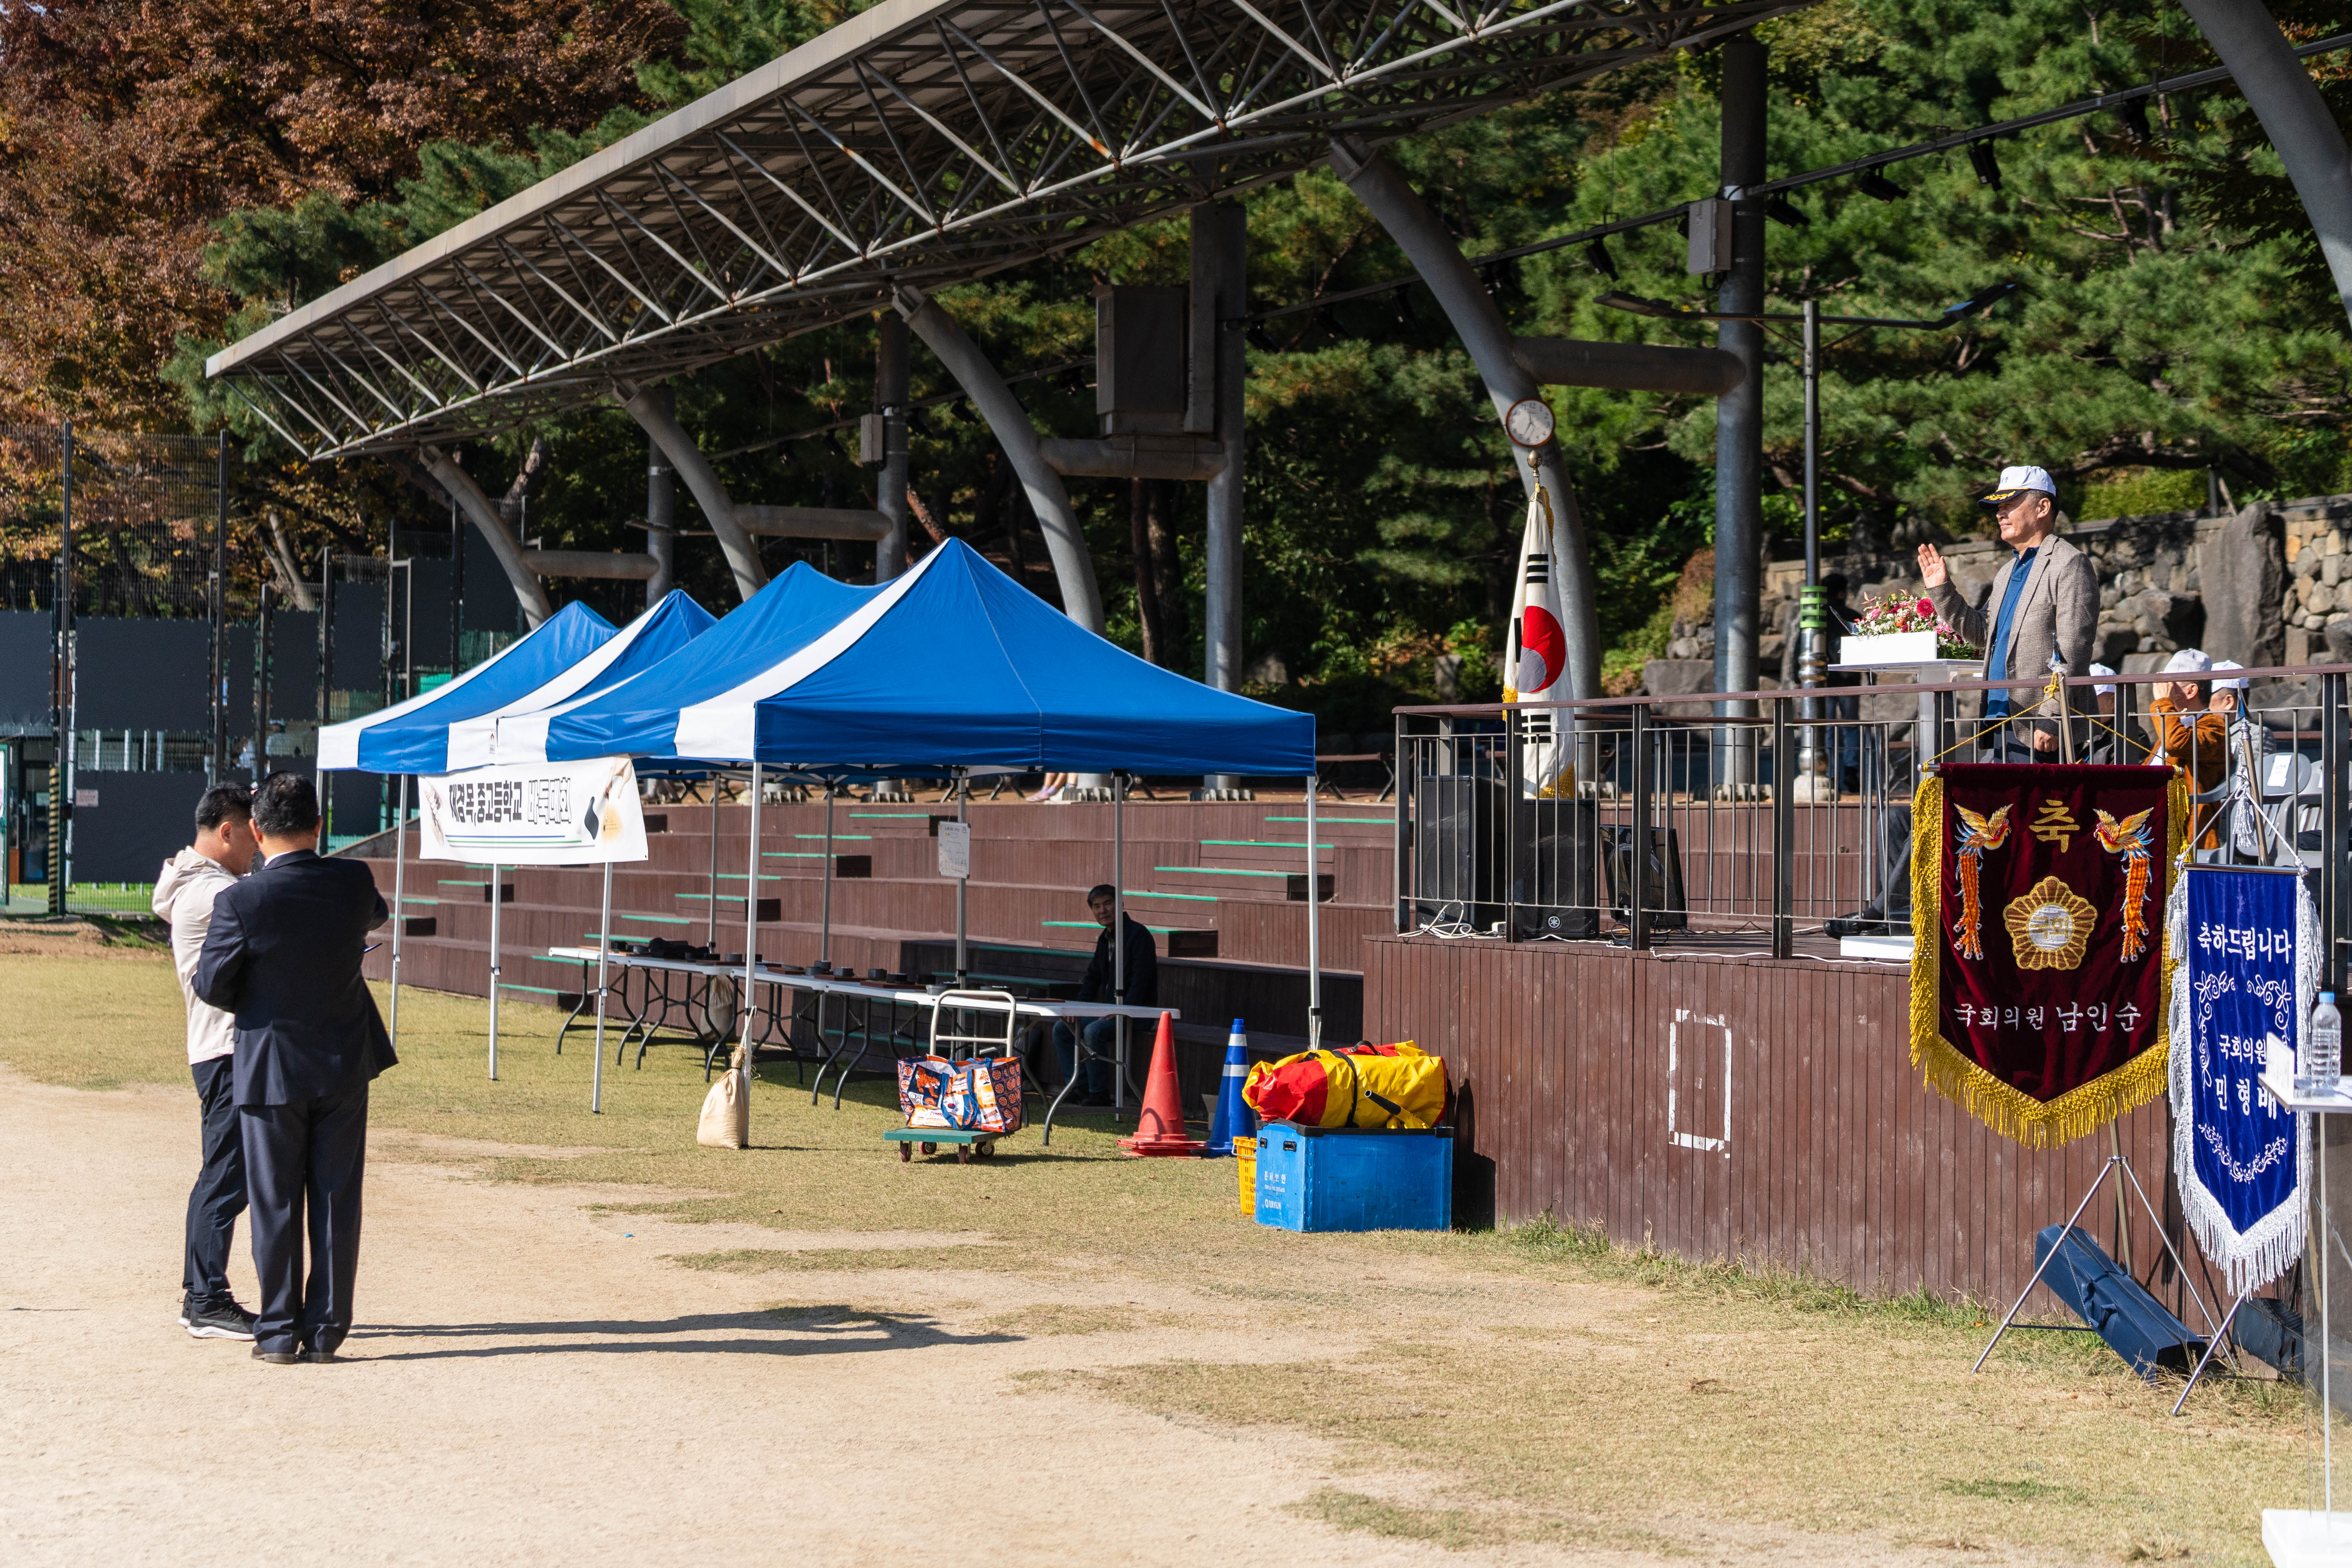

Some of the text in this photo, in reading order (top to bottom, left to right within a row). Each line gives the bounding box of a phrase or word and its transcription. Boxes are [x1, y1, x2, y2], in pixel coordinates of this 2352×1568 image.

[528, 777, 571, 825] 바둑대회
[2029, 799, 2080, 853] 축
[2030, 915, 2069, 939] 국회
[2197, 921, 2292, 964] 축하드립니다
[1954, 1001, 2141, 1032] 국회의원 남인순
[2219, 1034, 2267, 1065] 국회의원
